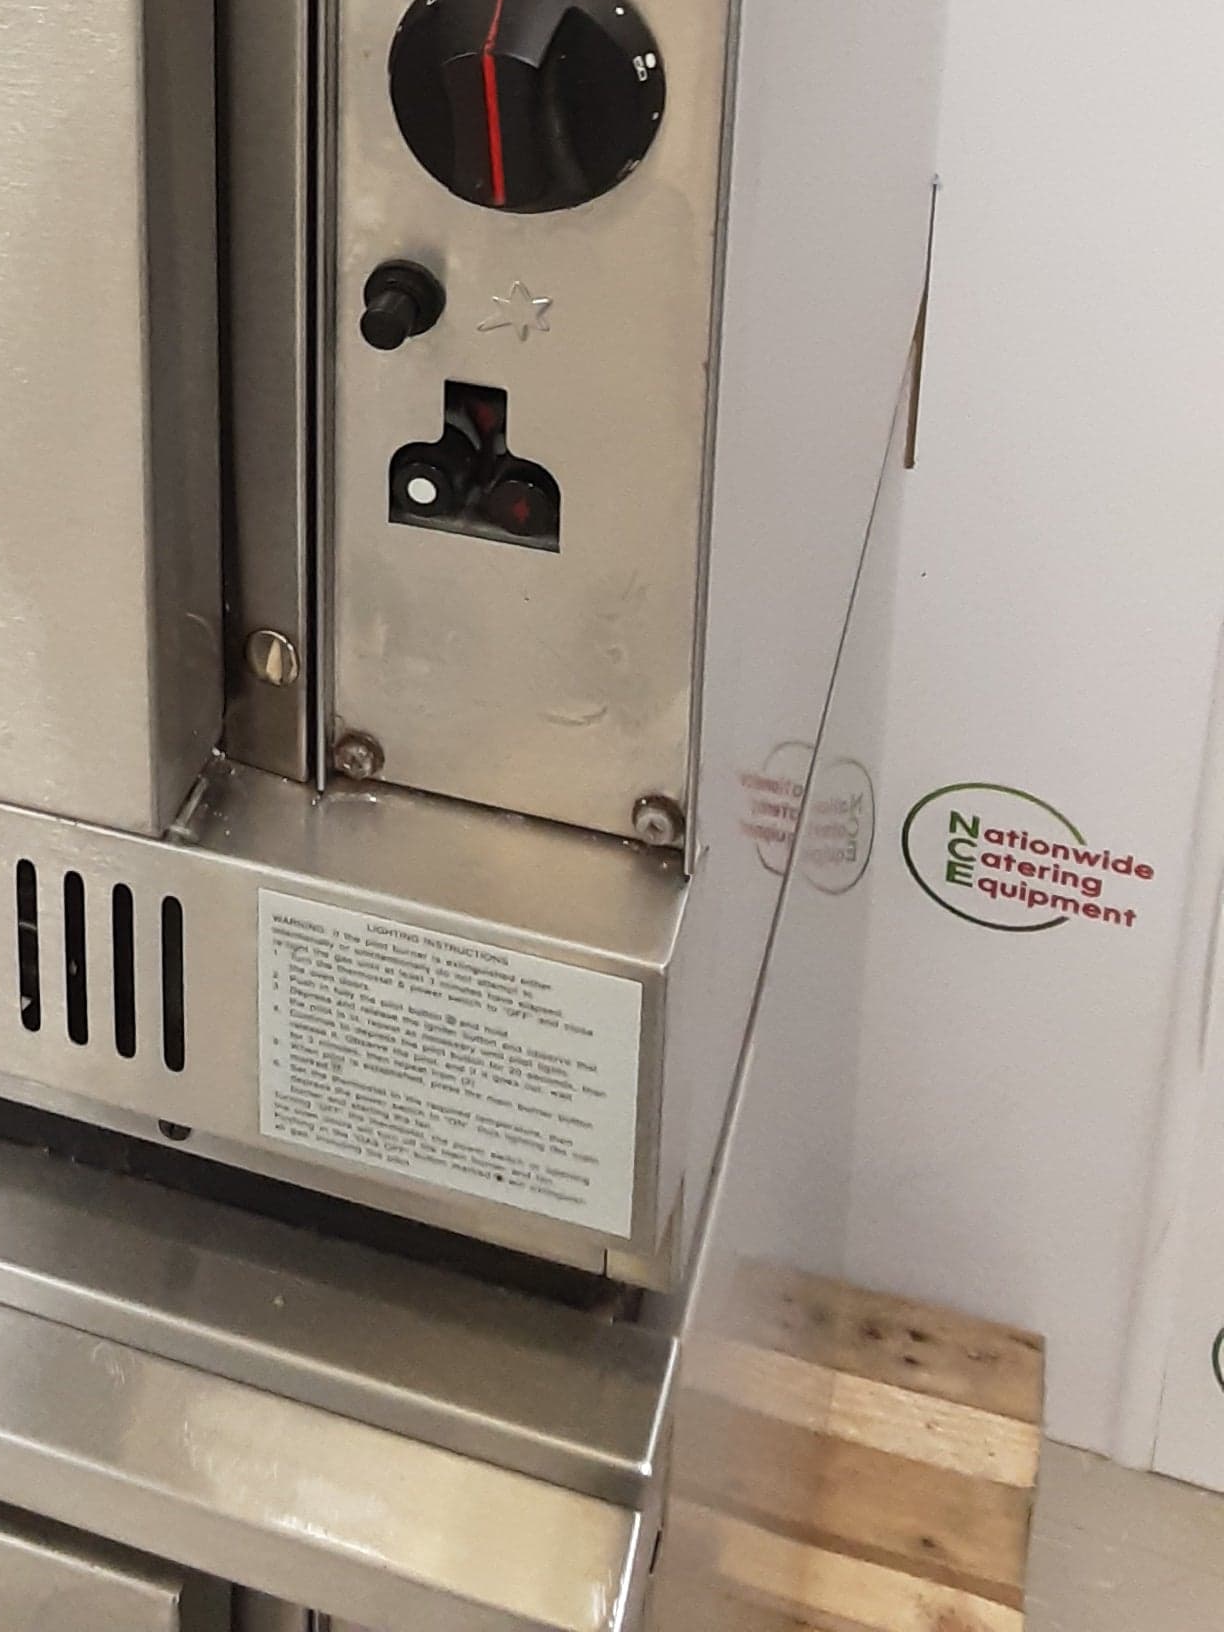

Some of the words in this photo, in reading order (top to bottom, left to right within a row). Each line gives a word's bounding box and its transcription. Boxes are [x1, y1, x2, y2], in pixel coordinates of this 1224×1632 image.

[947, 837, 1103, 898] Catering
[949, 810, 1155, 881] Nationwide
[945, 860, 1137, 928] Equipment
